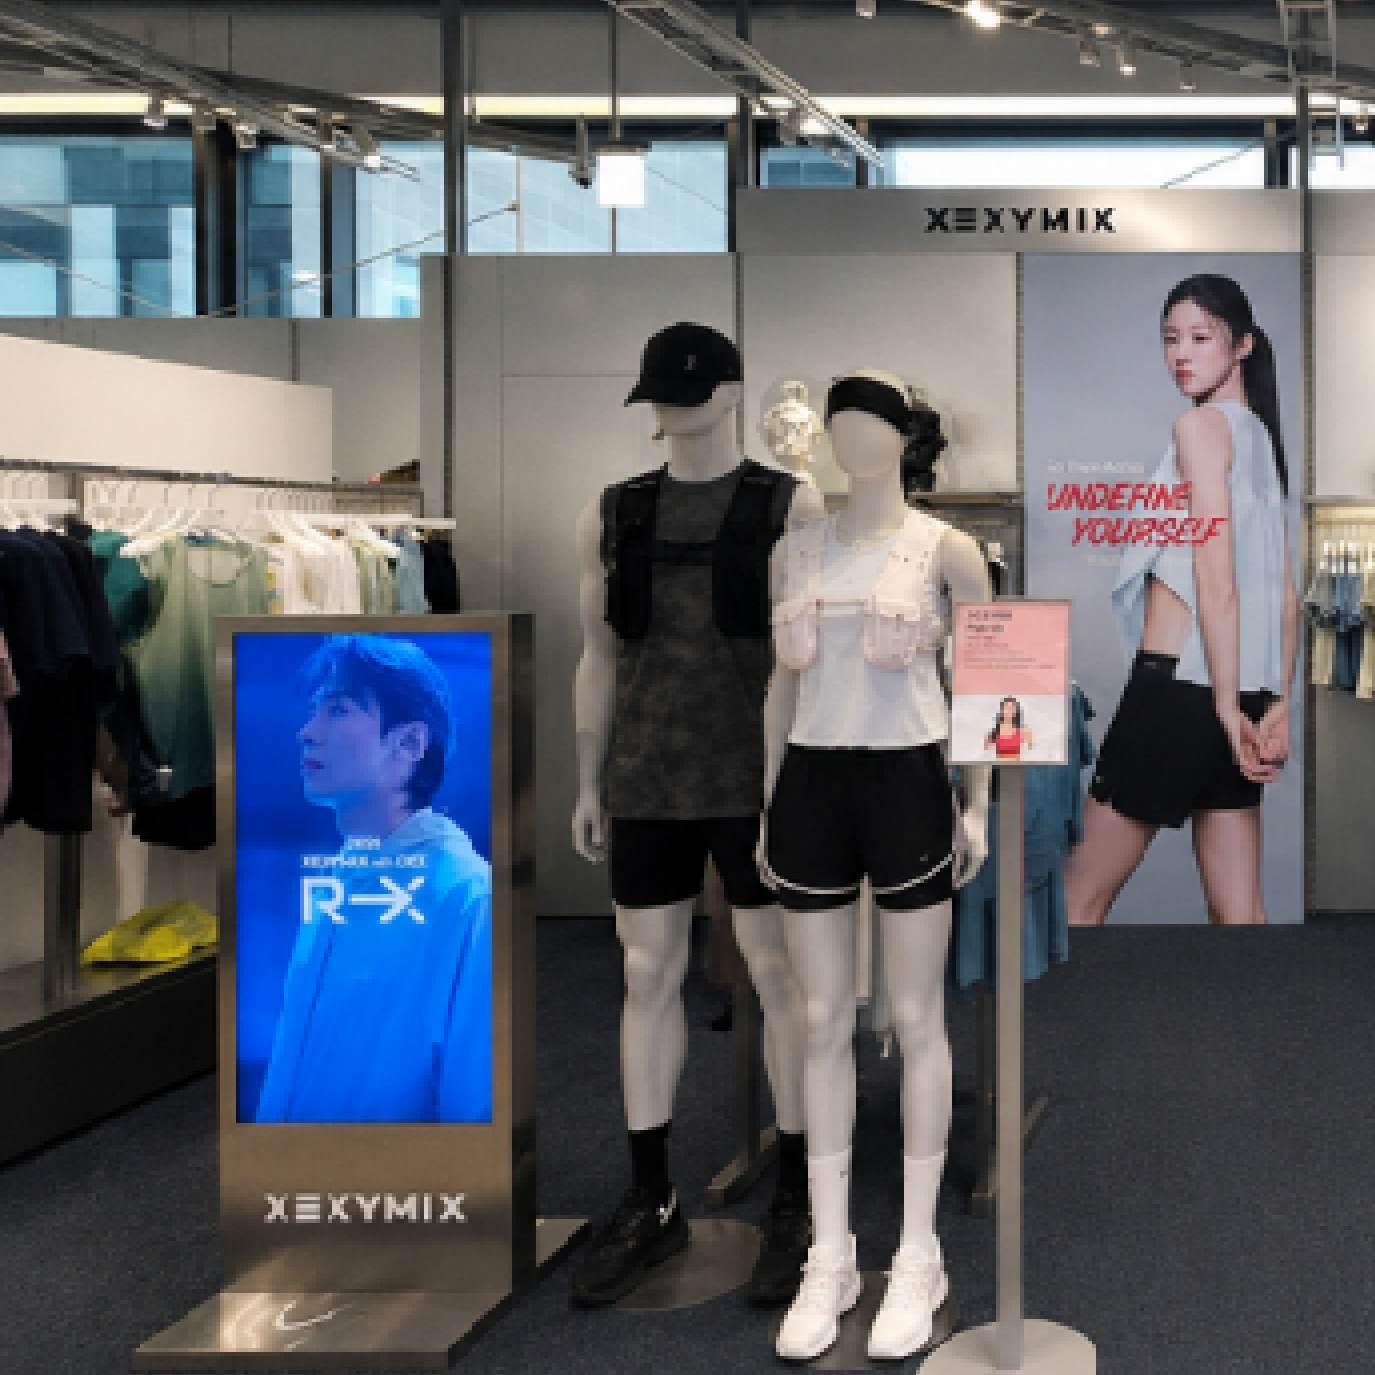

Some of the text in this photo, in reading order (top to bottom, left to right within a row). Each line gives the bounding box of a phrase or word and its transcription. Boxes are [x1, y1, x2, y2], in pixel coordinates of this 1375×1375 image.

[924, 208, 1116, 233] XEXYMIX
[1047, 482, 1193, 511] UNDEFINE
[1071, 517, 1229, 548] YOURSELF
[263, 1192, 468, 1224] XEXYMIX
